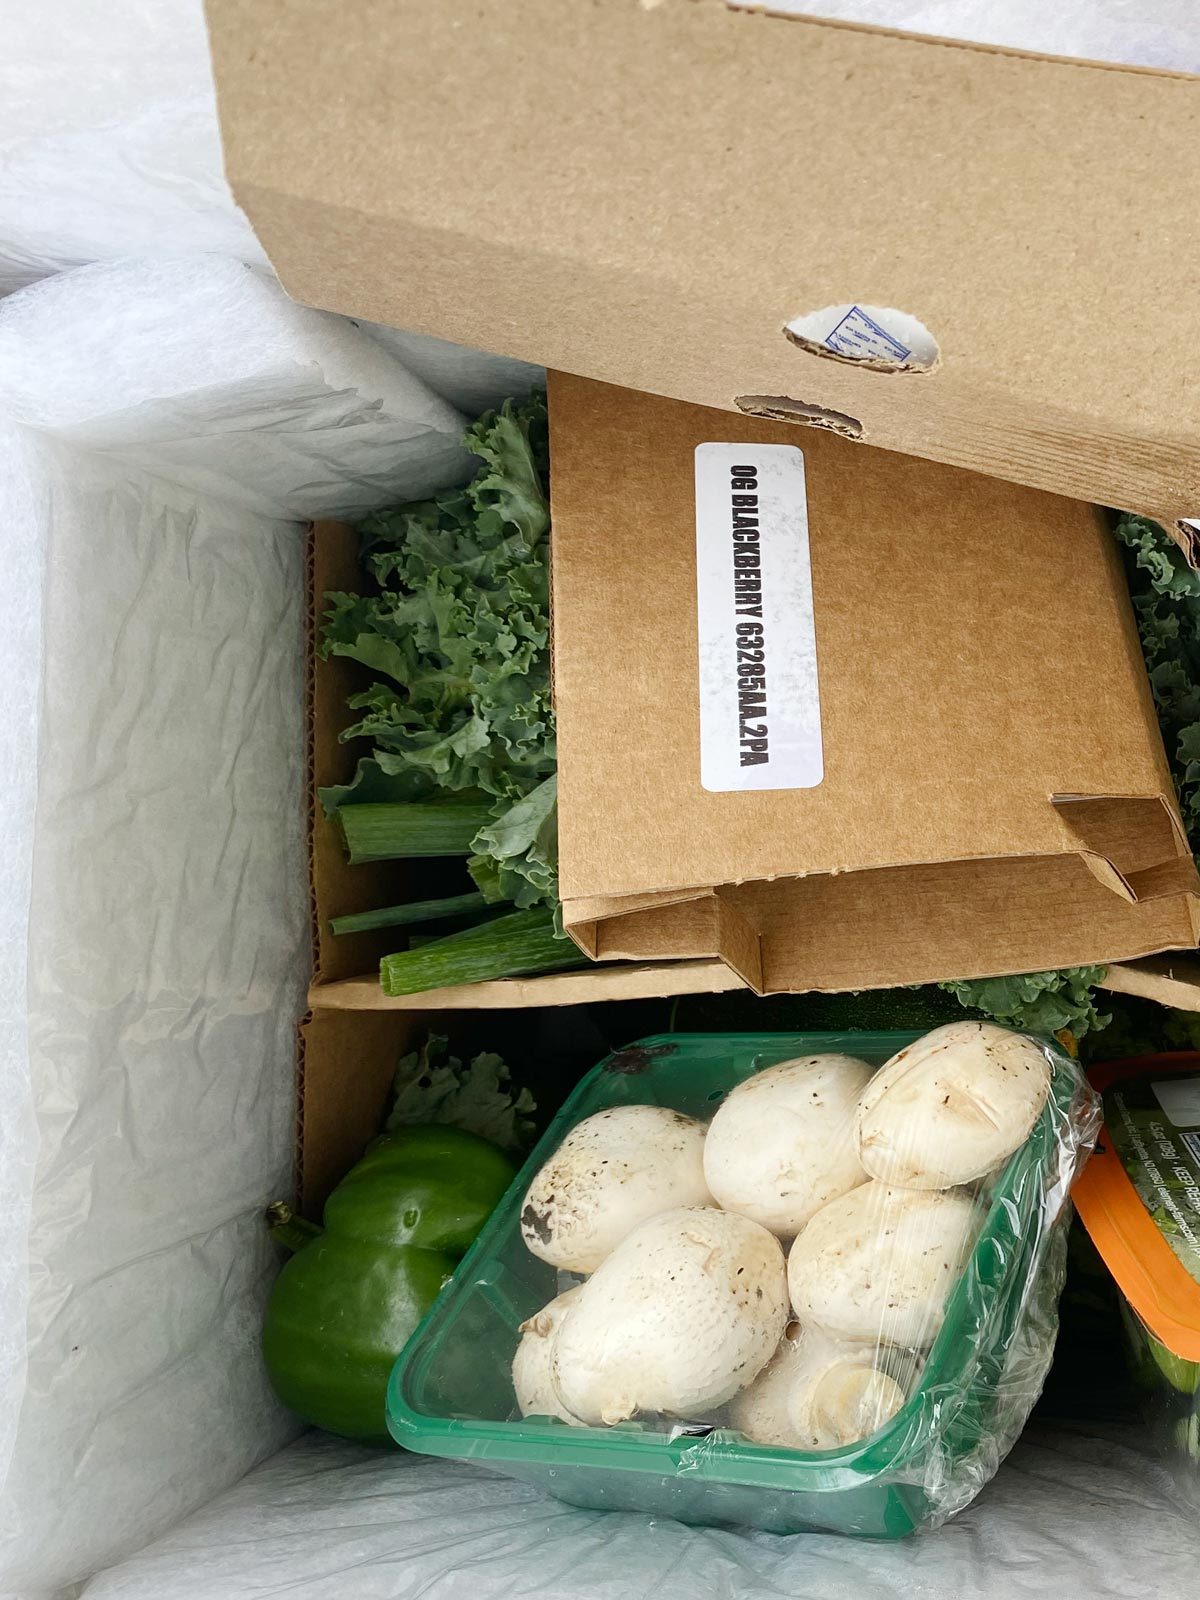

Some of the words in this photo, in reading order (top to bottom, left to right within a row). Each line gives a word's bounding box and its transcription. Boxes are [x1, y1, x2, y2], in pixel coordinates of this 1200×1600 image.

[730, 465, 758, 490] OG
[732, 494, 763, 619] BLACKBERRY
[1172, 1166, 1195, 1186] KEEP
